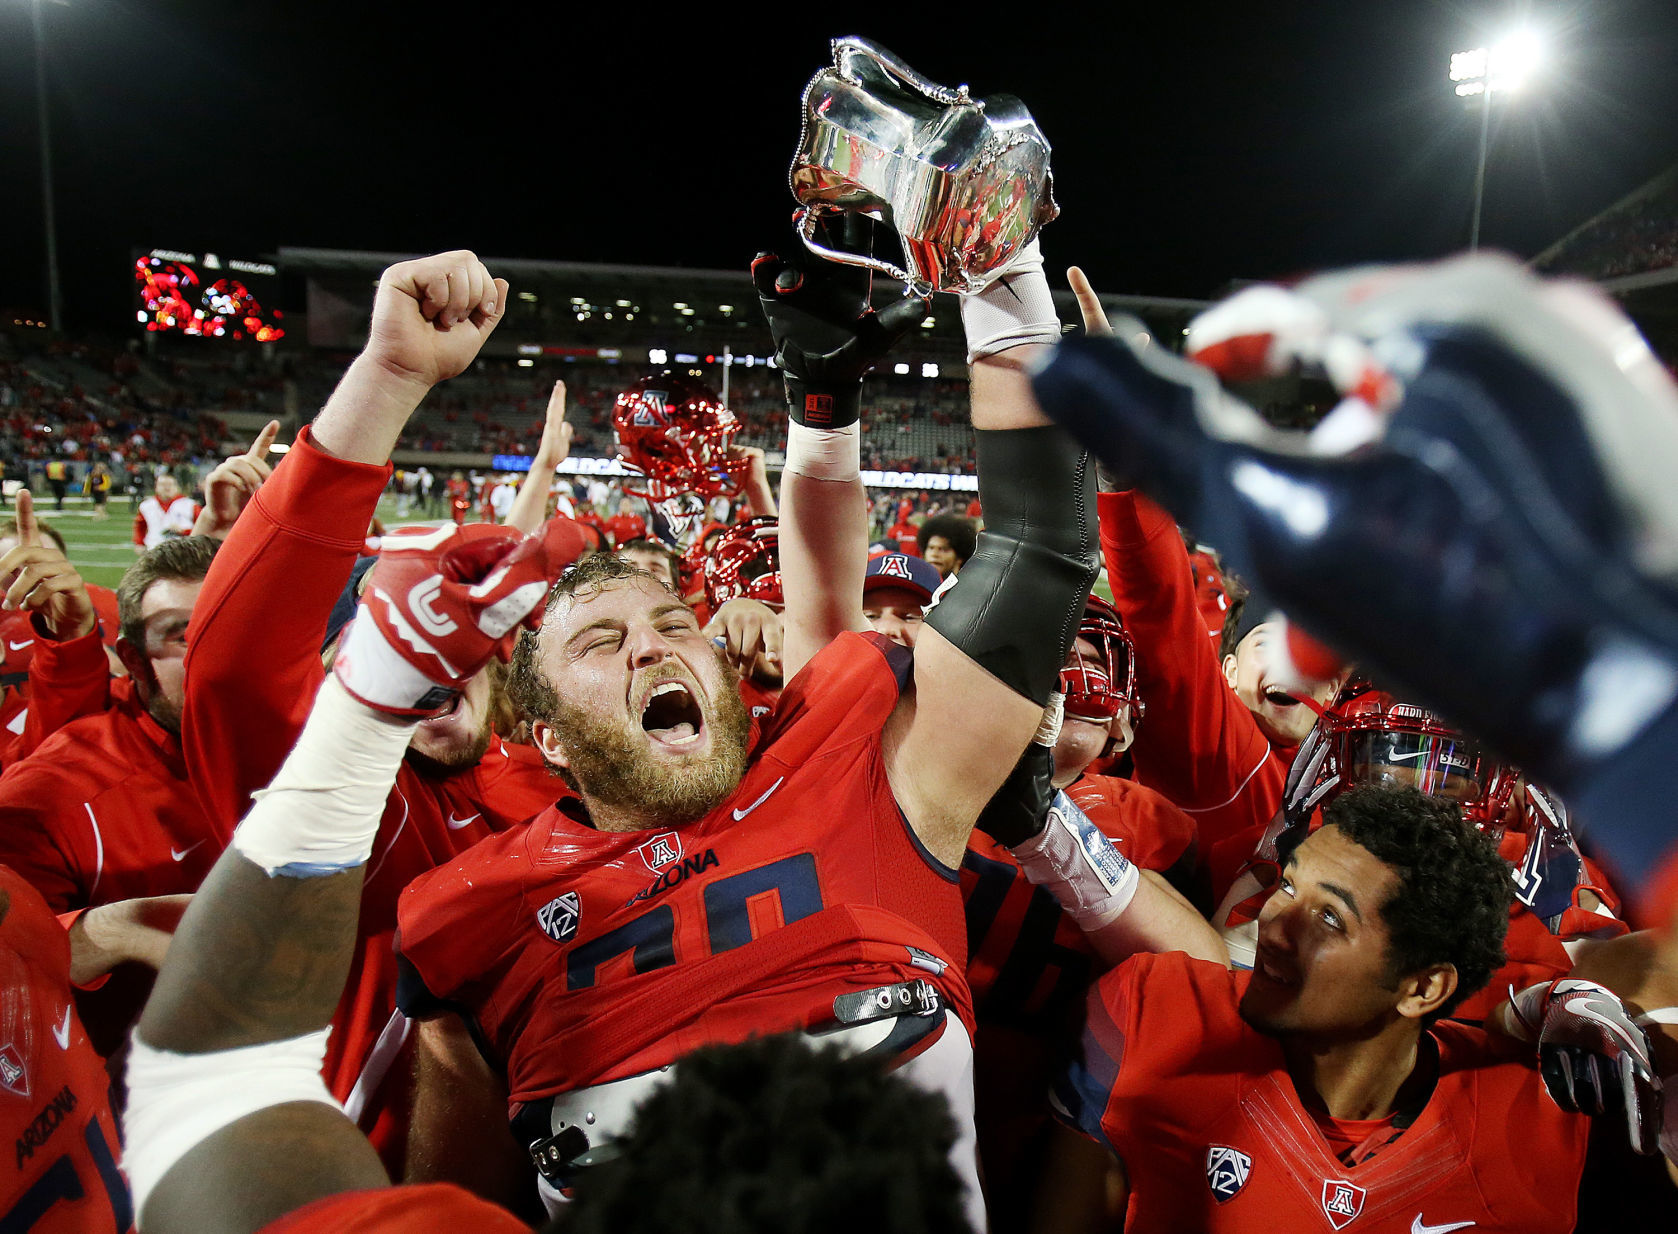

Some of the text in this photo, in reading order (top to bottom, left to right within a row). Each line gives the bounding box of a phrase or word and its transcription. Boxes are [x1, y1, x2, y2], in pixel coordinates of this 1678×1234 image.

[877, 554, 912, 580] A
[651, 838, 678, 870] A
[537, 891, 579, 935] PAC
[551, 912, 577, 940] 12
[15, 1084, 78, 1170] ARIZONA
[1207, 1147, 1252, 1187] PAC
[1211, 1170, 1237, 1195] 12
[1327, 1186, 1355, 1216] A
